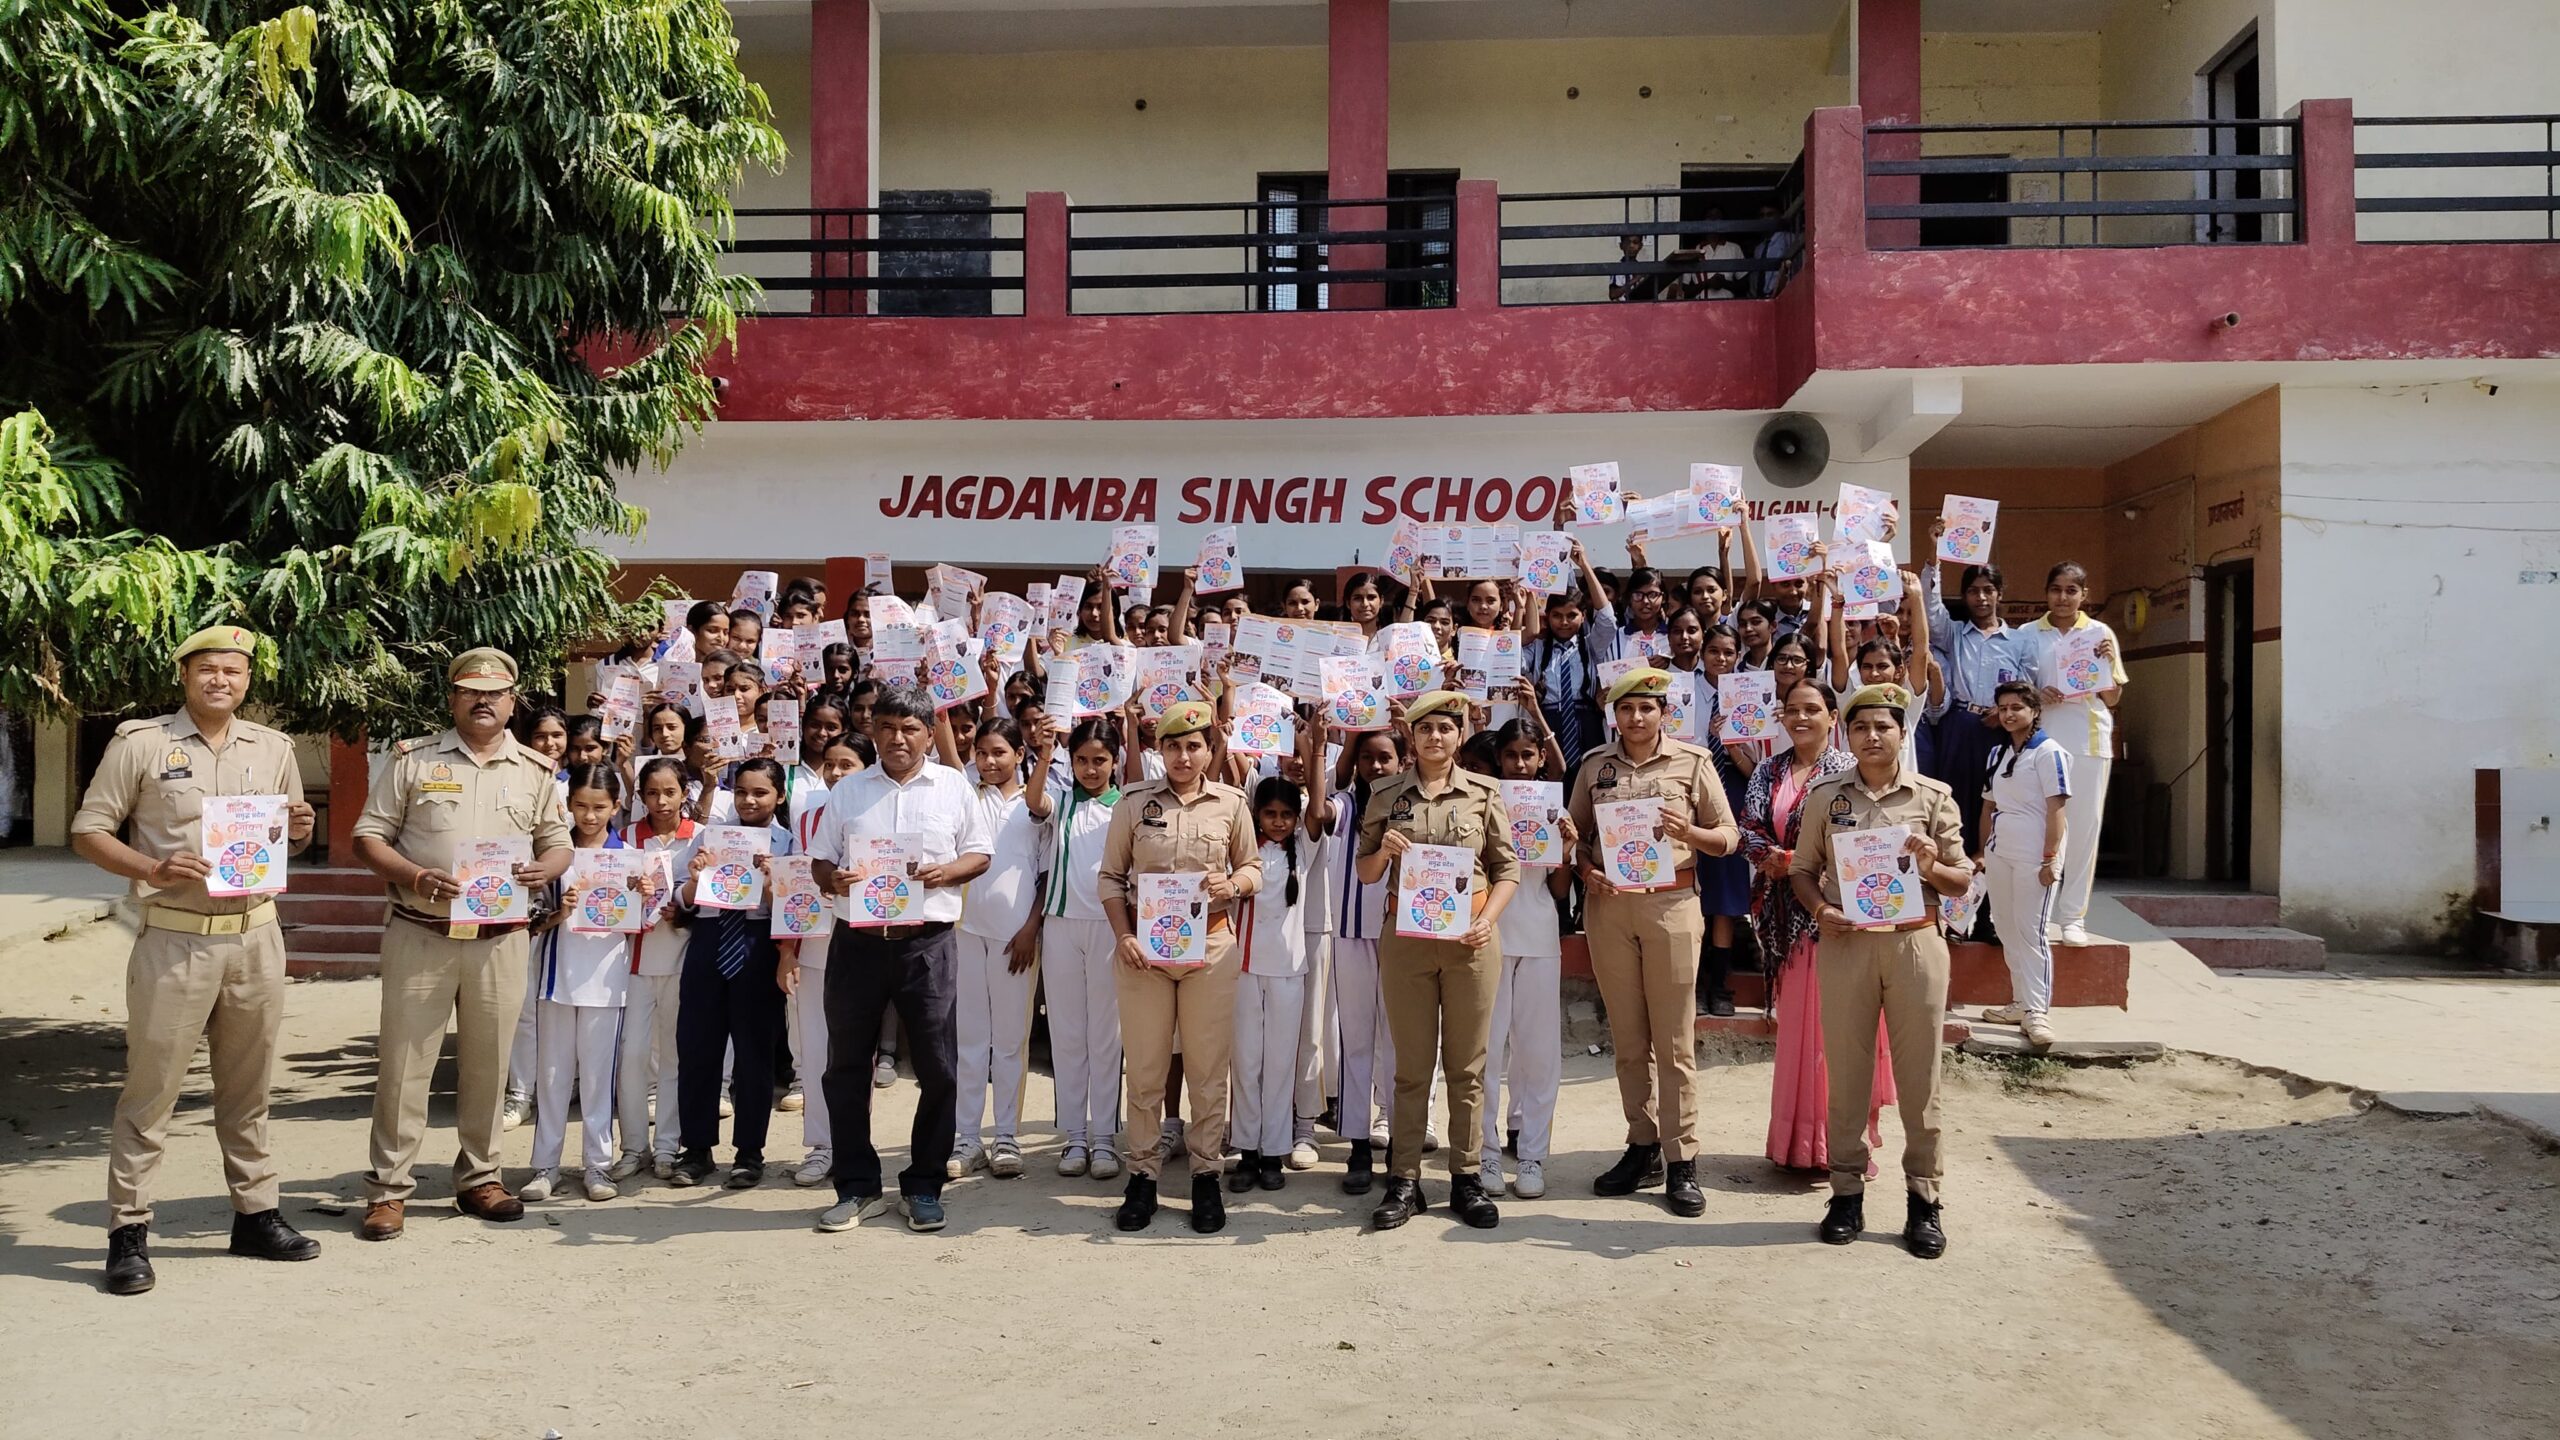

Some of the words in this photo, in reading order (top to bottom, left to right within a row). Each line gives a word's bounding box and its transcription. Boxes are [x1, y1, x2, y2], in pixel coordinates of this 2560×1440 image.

[878, 475, 1158, 522] JAGDAMBA
[1177, 476, 1348, 525] SINGH
[1361, 475, 1577, 525] SCHOOL
